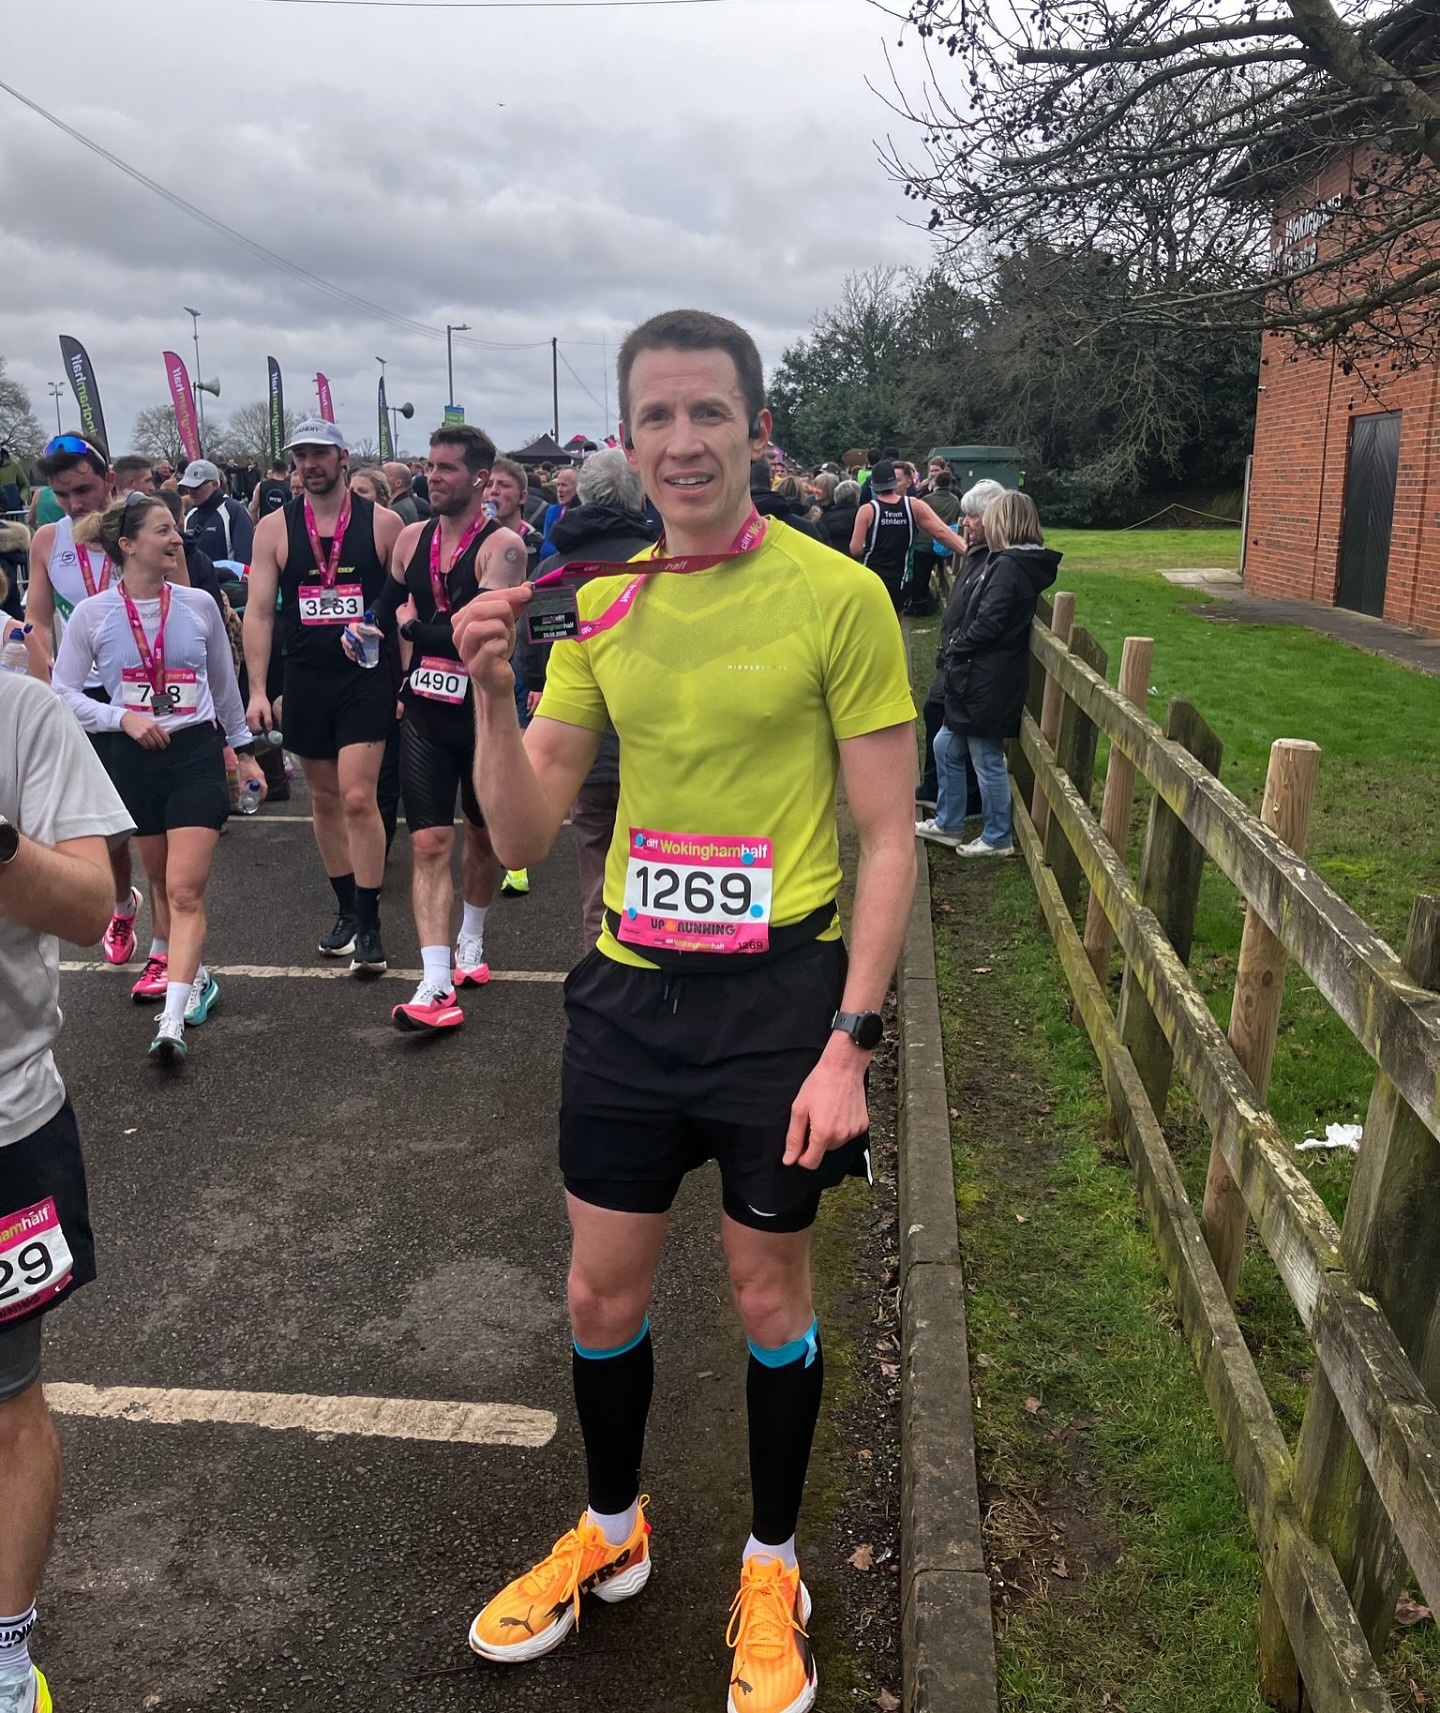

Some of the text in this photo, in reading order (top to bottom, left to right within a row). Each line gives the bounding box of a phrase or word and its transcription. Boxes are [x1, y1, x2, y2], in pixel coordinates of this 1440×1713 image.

[881, 518, 907, 526] Striders
[414, 670, 460, 693] 1490
[137, 684, 182, 704] 78
[660, 839, 769, 861] Wokinghamhalf
[635, 865, 752, 916] 1269
[651, 918, 665, 930] UP
[677, 920, 736, 936] RUNNING
[580, 1549, 631, 1592] TRO
